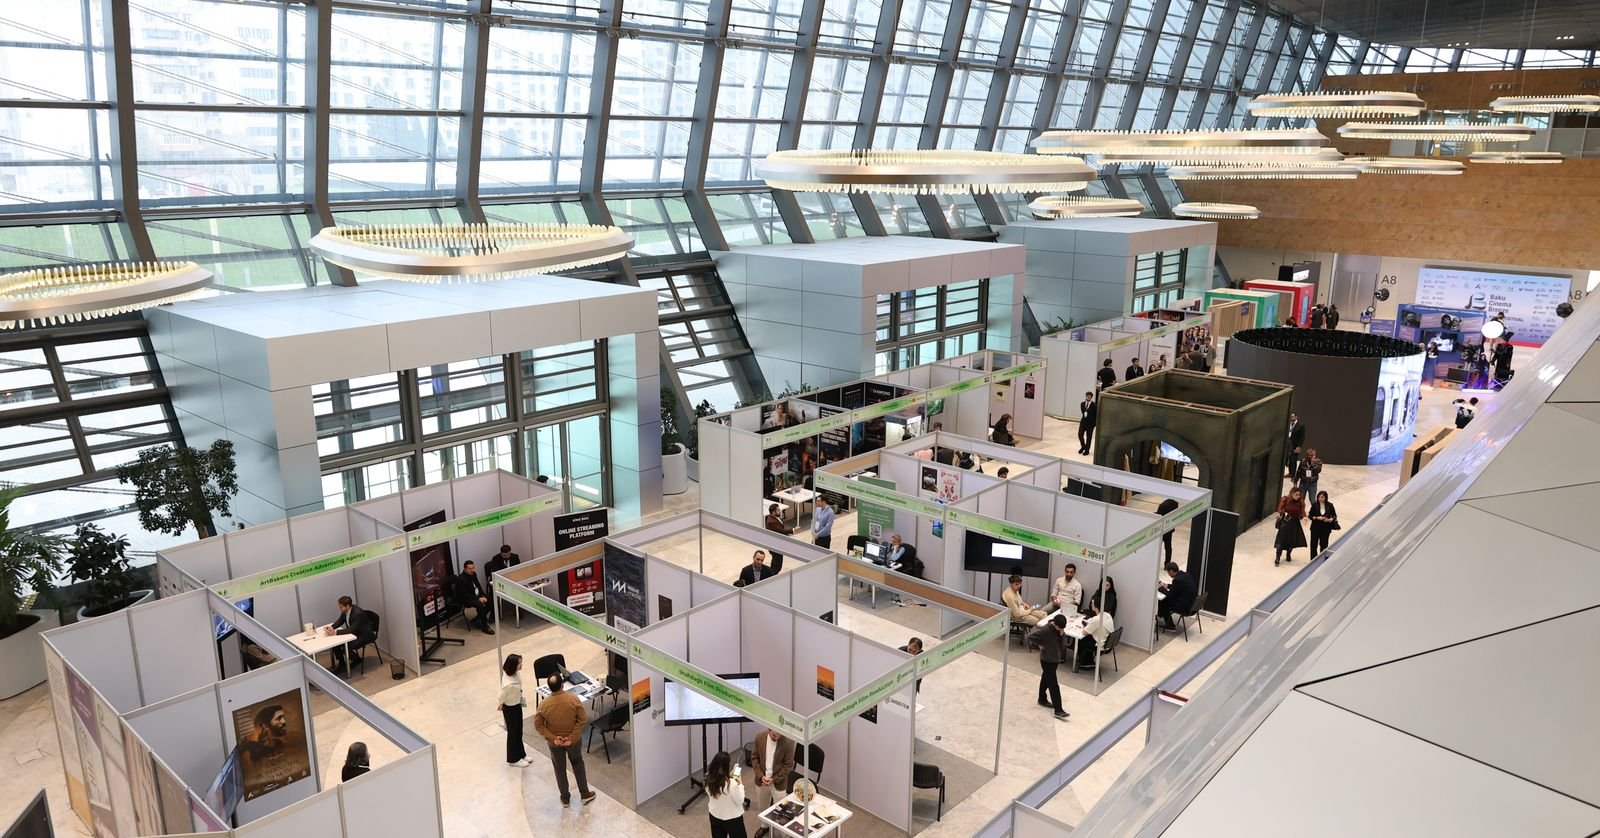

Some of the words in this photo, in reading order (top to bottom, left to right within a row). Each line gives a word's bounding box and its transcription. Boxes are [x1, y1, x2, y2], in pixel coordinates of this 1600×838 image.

[1381, 275, 1397, 285] A8
[476, 516, 500, 525] Streaming
[577, 523, 605, 532] STREAMING
[569, 530, 595, 539] PLATFORM
[1016, 532, 1041, 542] Animation
[260, 574, 289, 586] ArtBakers
[290, 567, 313, 578] Creative
[314, 558, 345, 571] Advertising
[345, 552, 366, 562] Agency
[557, 610, 579, 625] Production
[955, 641, 965, 651] Film
[965, 630, 987, 646] Production
[679, 669, 703, 686] Shahdagh
[703, 679, 716, 690] Film
[715, 686, 744, 703] Production
[833, 702, 857, 719] Shahdagh
[858, 694, 869, 705] Film
[868, 680, 894, 699] Production
